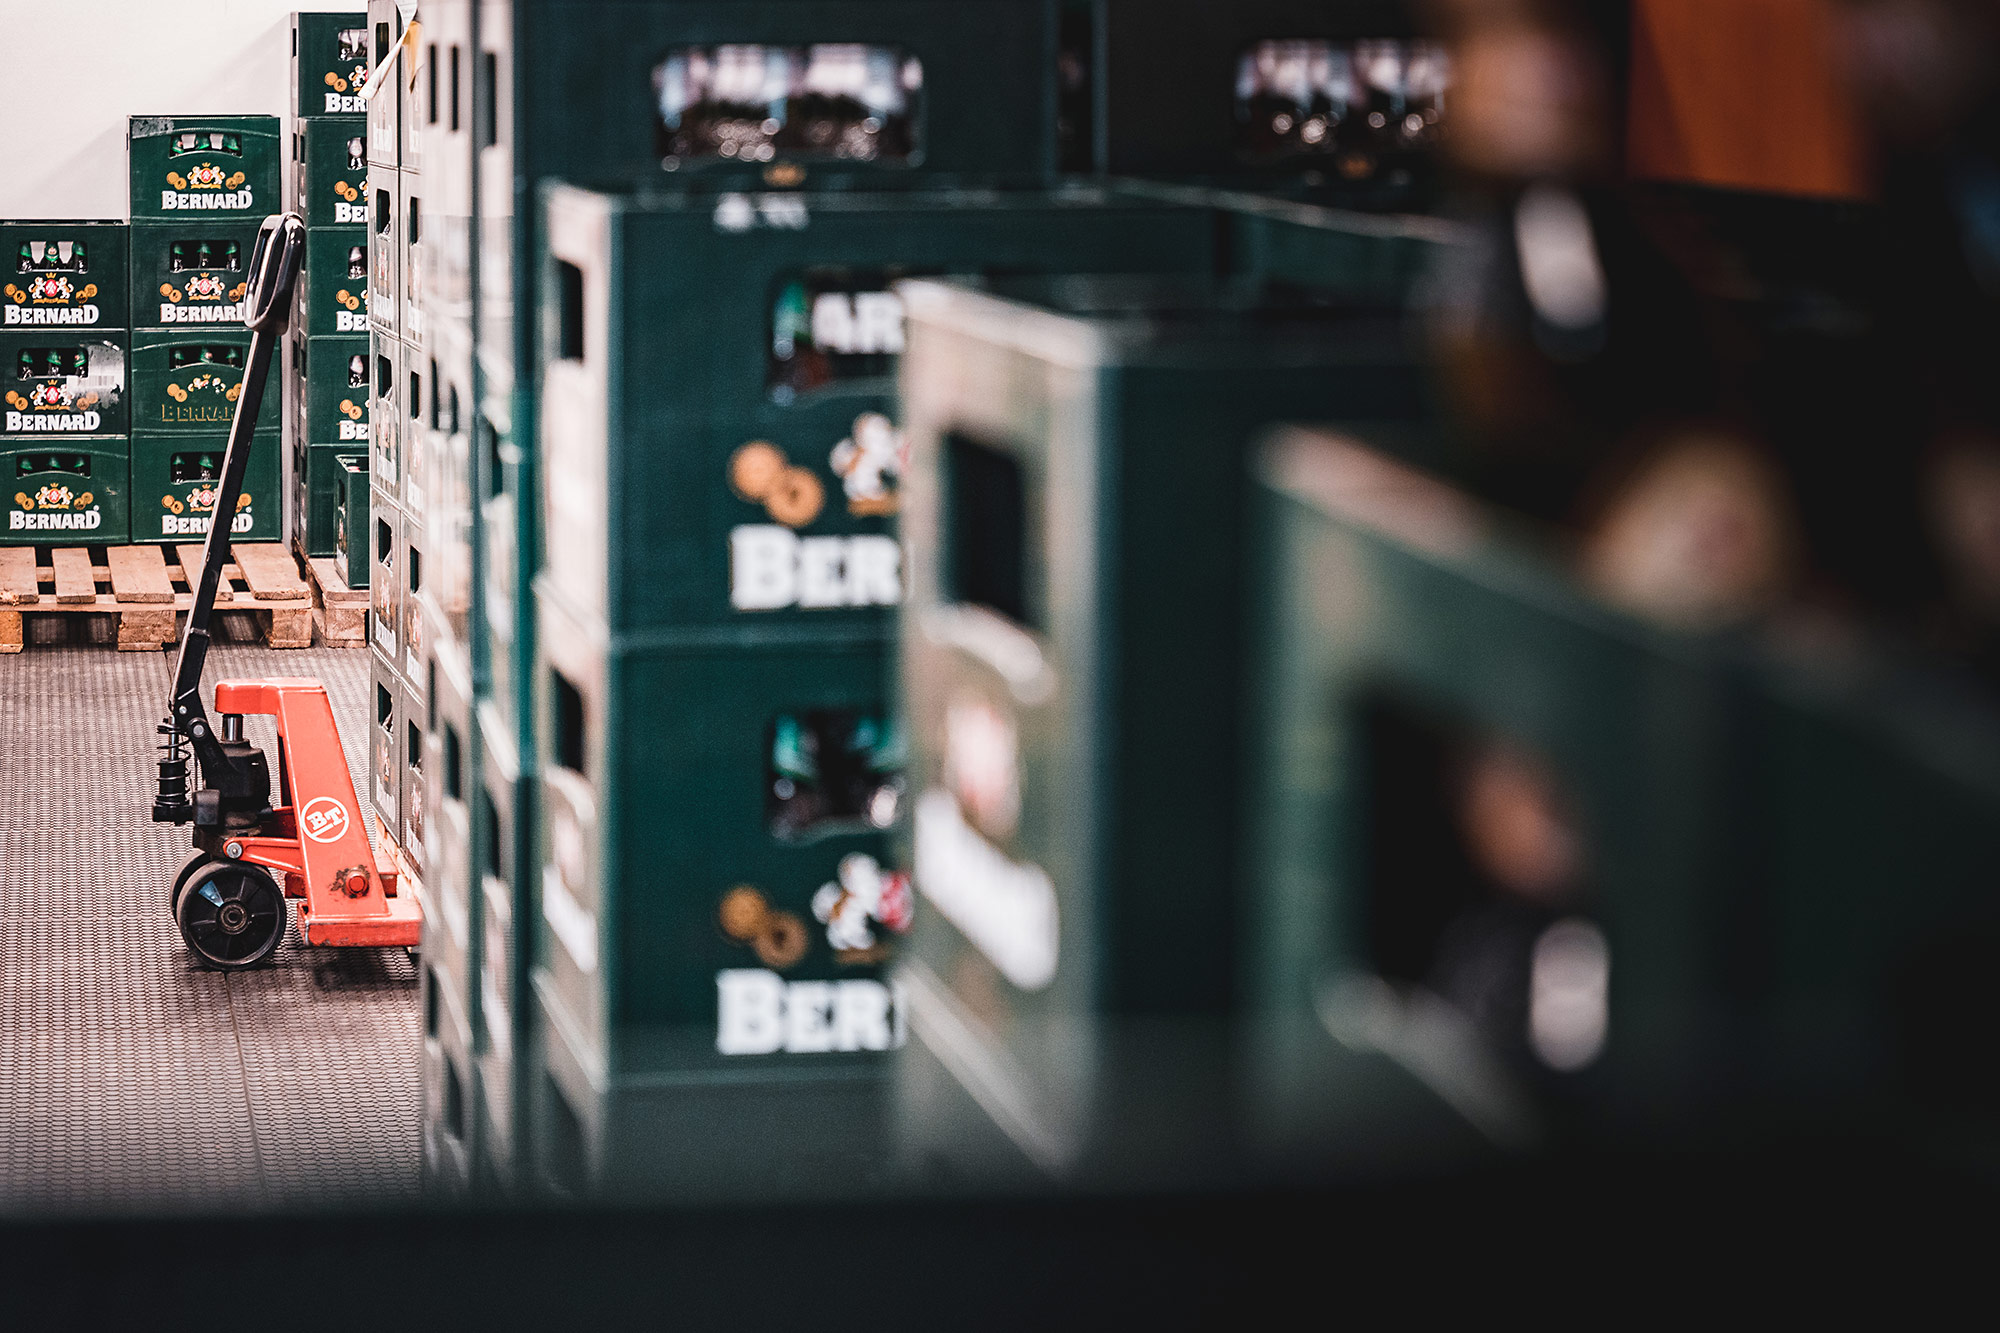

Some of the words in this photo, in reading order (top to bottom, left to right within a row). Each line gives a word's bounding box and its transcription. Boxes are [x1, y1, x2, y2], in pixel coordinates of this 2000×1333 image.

[161, 190, 253, 210] BERNARD
[4, 304, 99, 325] BERNARD
[6, 411, 100, 431] BERNARD
[162, 404, 234, 422] BERNAR
[9, 510, 101, 530] BERNARD
[162, 513, 253, 534] BERND
[306, 806, 345, 834] BT
[716, 968, 905, 1055] BER
